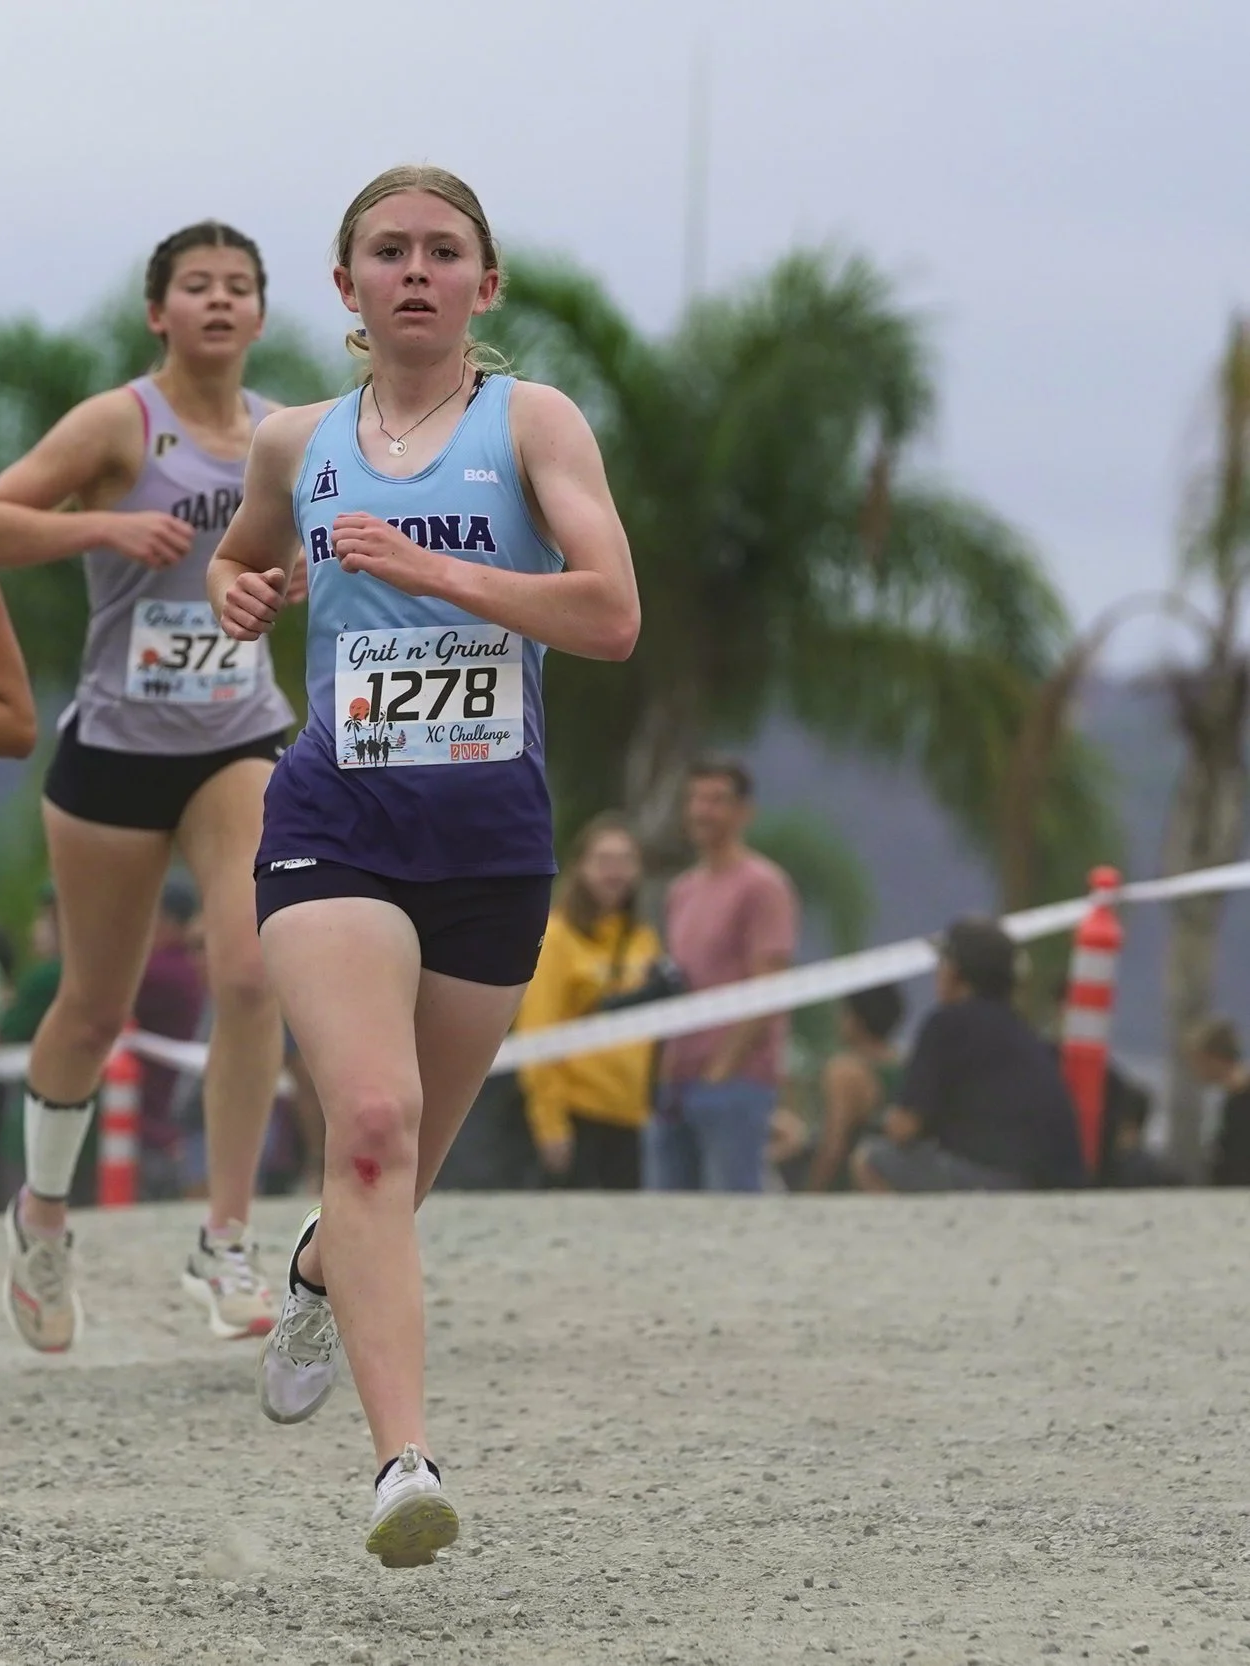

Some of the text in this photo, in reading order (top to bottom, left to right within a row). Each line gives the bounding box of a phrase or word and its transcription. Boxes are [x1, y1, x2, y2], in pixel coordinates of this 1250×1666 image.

[310, 514, 497, 566] RONA
[162, 633, 241, 671] 372
[349, 636, 399, 671] Grit
[436, 631, 510, 666] Grind
[366, 667, 498, 723] 1278
[425, 724, 511, 746] XC Challenge
[451, 743, 490, 760] 2025
